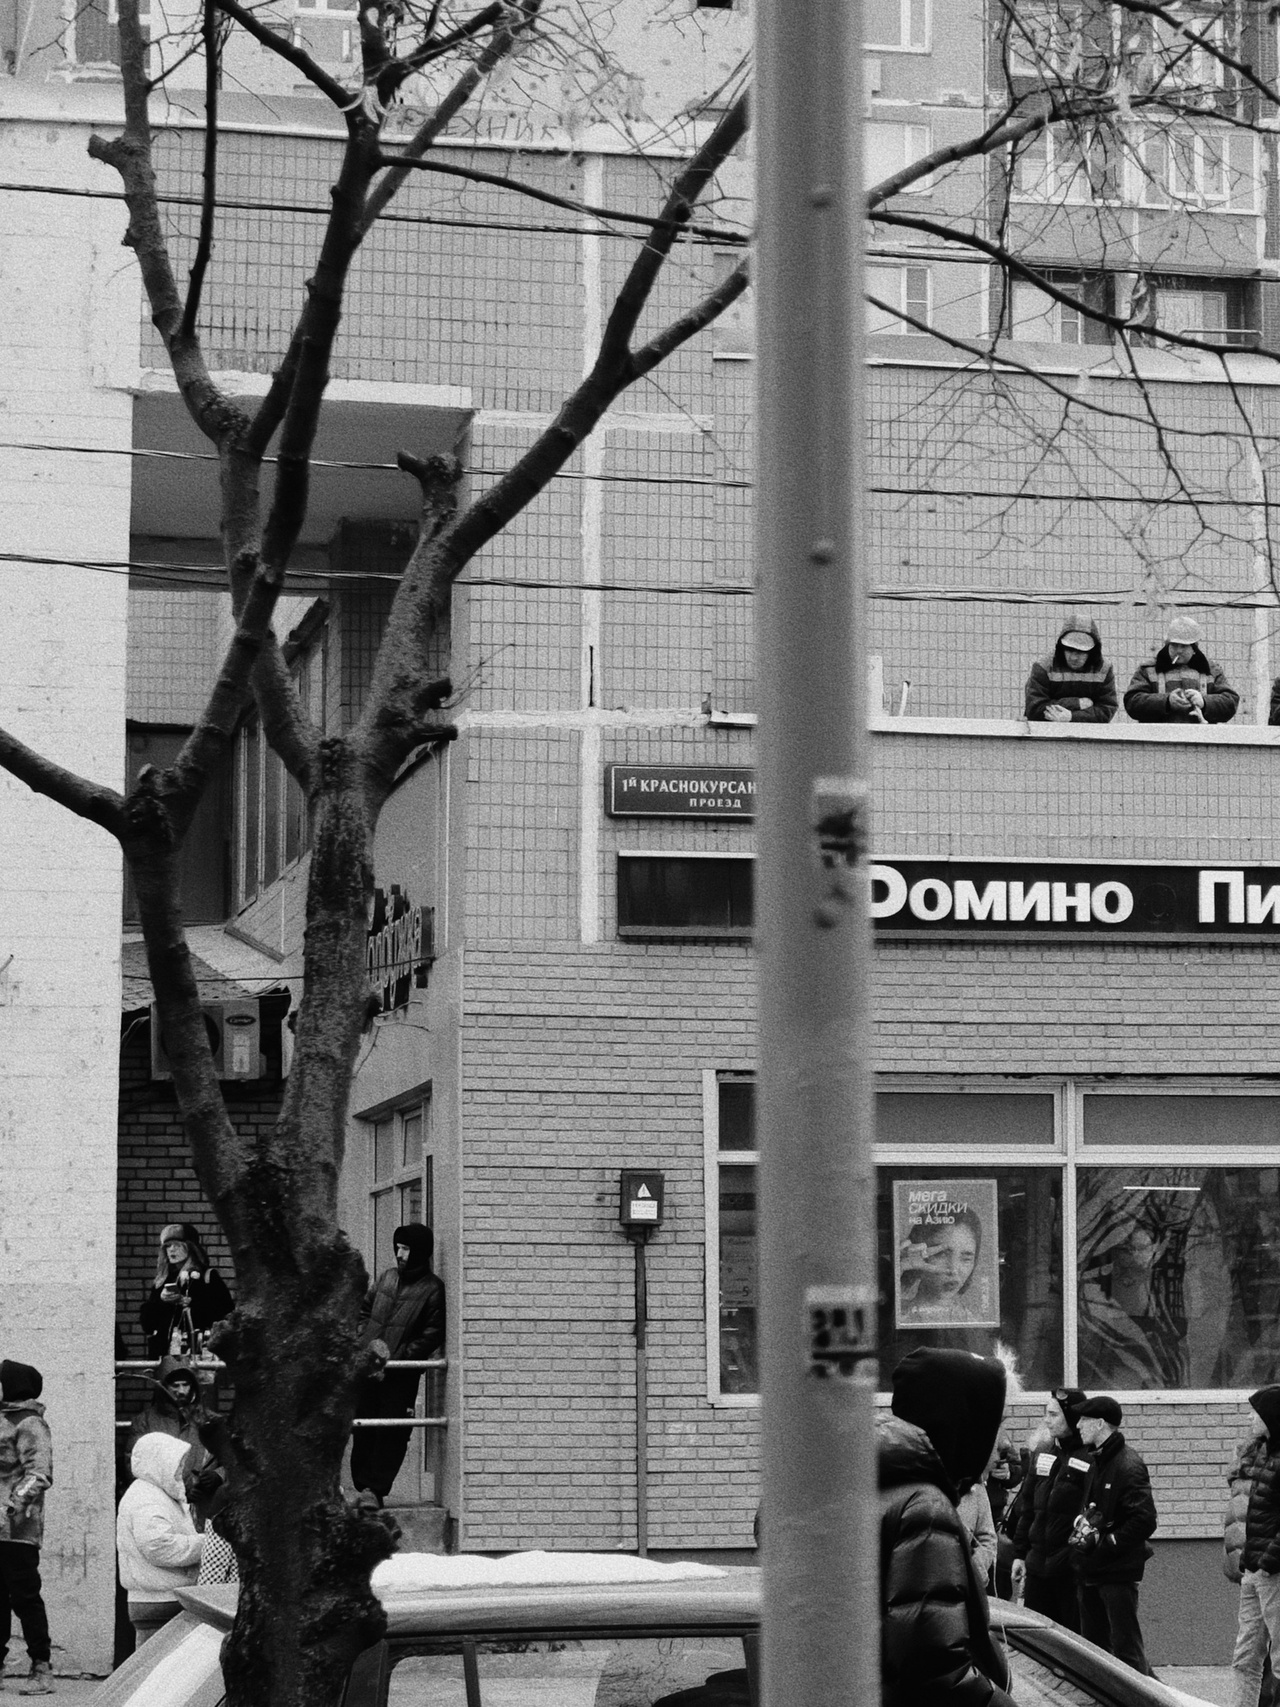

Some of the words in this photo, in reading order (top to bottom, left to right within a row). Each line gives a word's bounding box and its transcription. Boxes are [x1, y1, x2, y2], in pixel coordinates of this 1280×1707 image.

[689, 798, 742, 808] ПРОЕЗД
[908, 1216, 923, 1225] на
[925, 1214, 956, 1225] Азию
